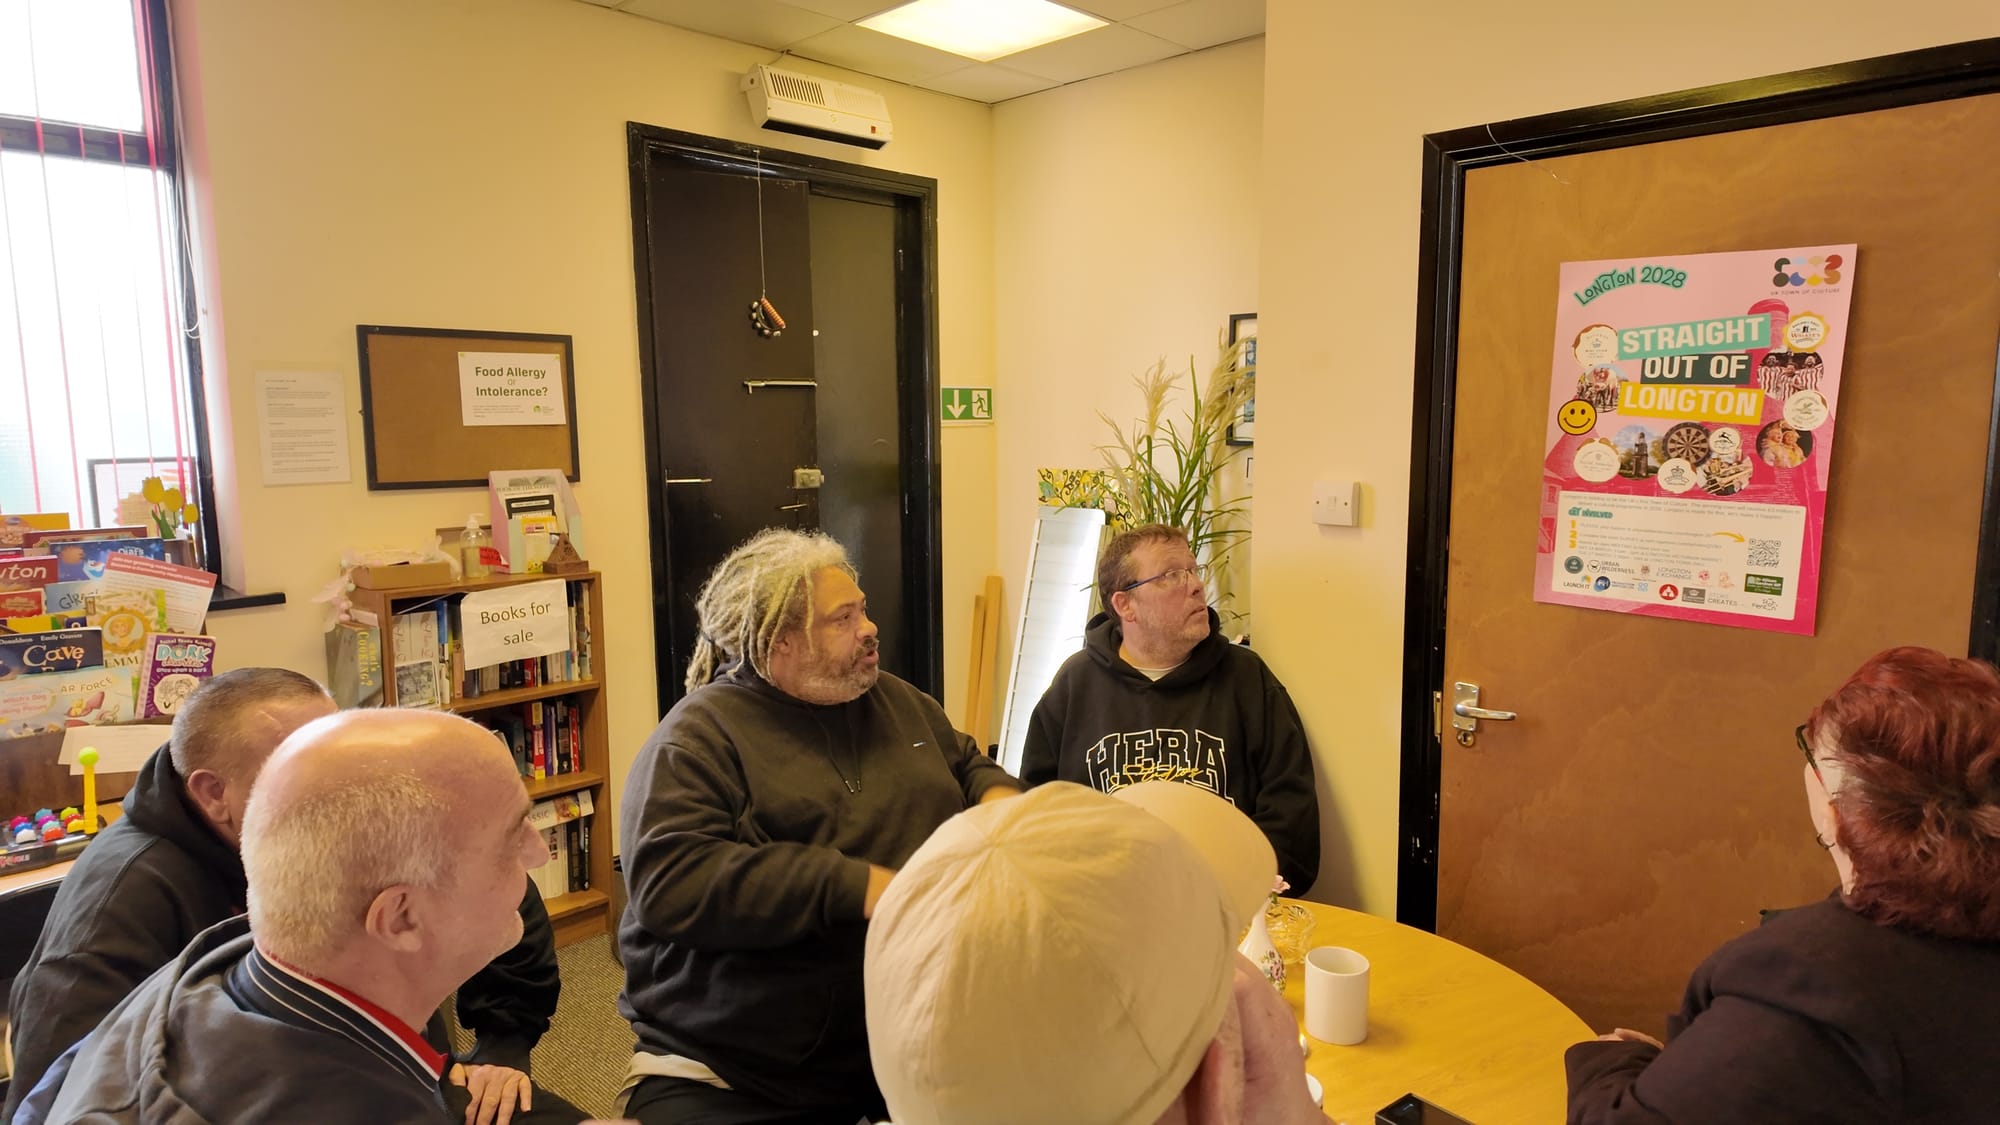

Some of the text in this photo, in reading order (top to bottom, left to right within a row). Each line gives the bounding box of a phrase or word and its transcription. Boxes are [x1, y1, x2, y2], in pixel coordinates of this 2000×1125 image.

[1573, 265, 1687, 306] LONGTON 2028
[1622, 316, 1764, 353] STRAIGHT
[475, 366, 546, 379] Food Allergy
[1644, 355, 1749, 379] OUT OF
[476, 386, 548, 396] Intolerance?
[1623, 385, 1758, 417] LONGTON
[0, 564, 47, 580] ton
[480, 602, 551, 624] Books for
[503, 630, 534, 646] sale
[23, 644, 85, 667] Cave
[156, 644, 212, 663] DORK
[80, 676, 112, 692] FORCE
[1086, 729, 1236, 807] HERA
